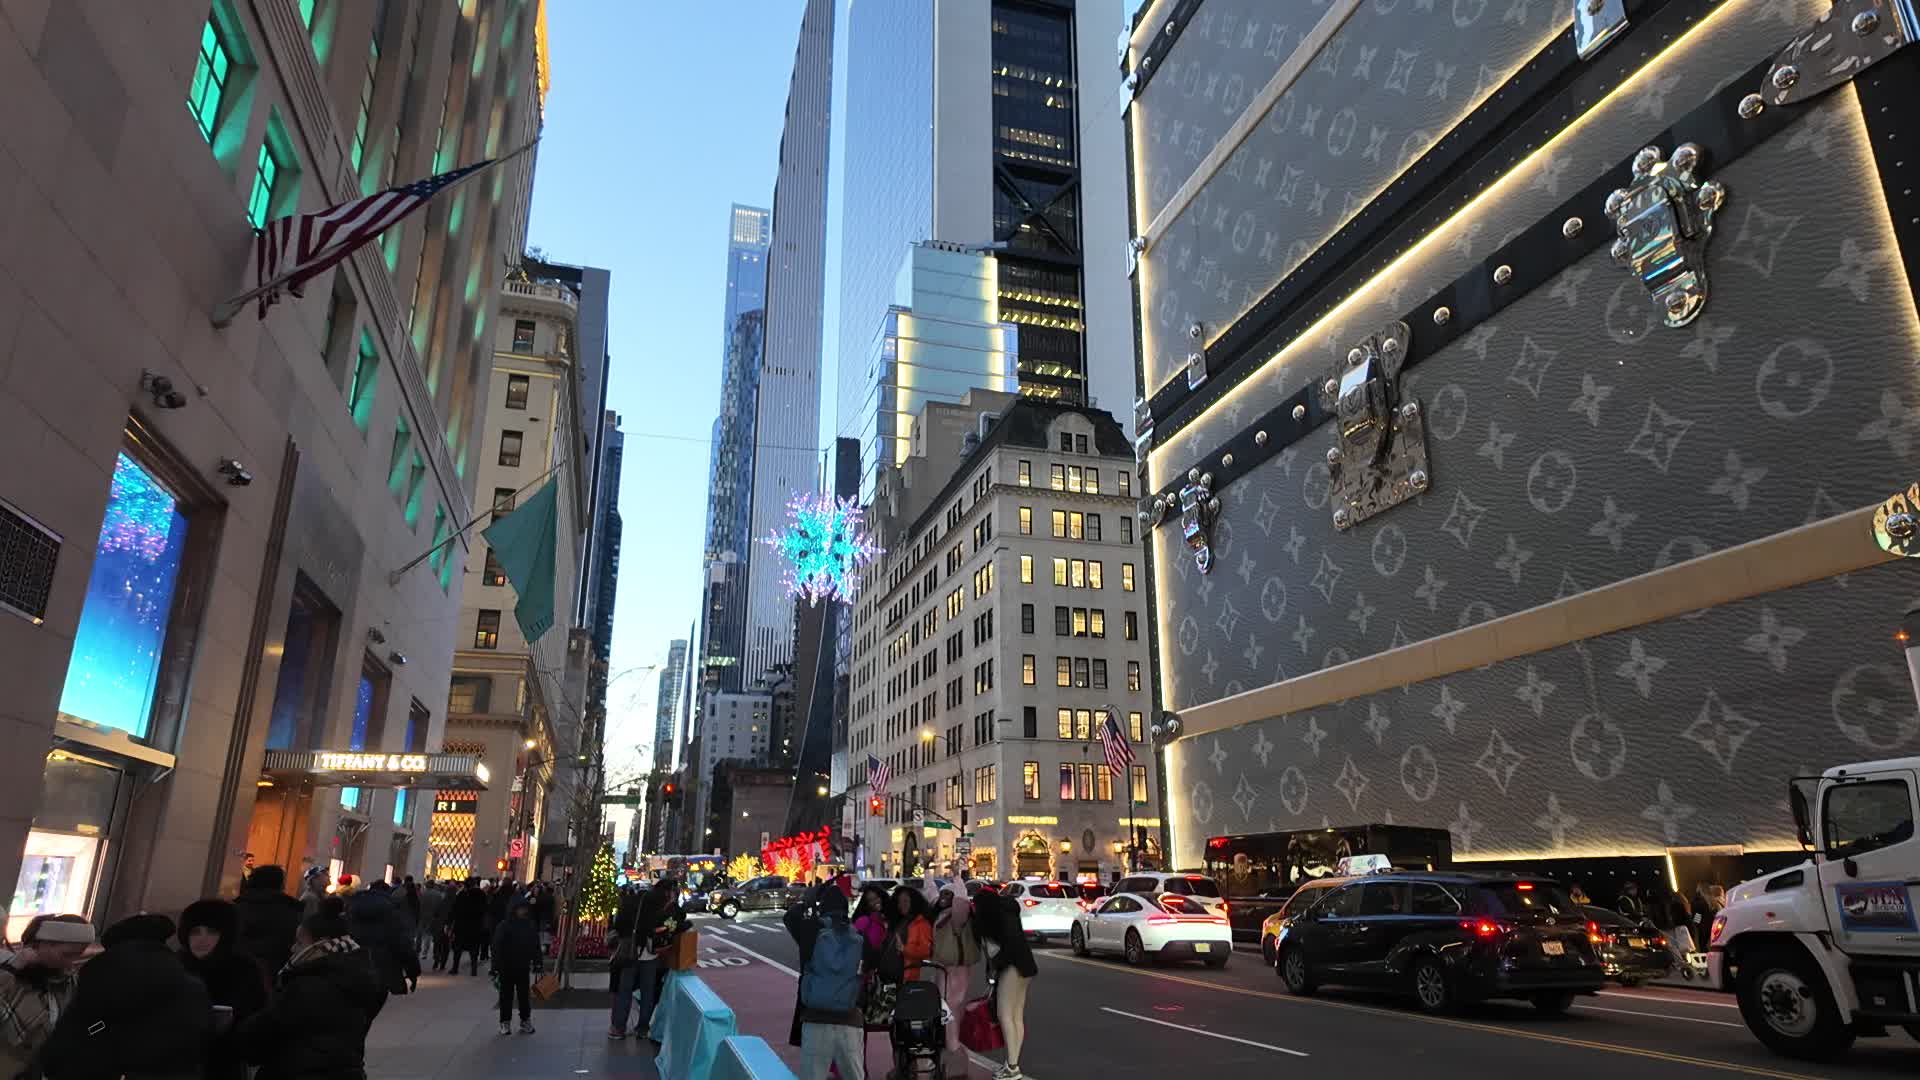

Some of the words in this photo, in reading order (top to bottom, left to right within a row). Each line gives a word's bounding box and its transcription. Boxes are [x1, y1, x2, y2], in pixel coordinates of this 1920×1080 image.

[321, 753, 386, 770] TIFFANY
[387, 754, 400, 770] &
[697, 957, 751, 968] NO
